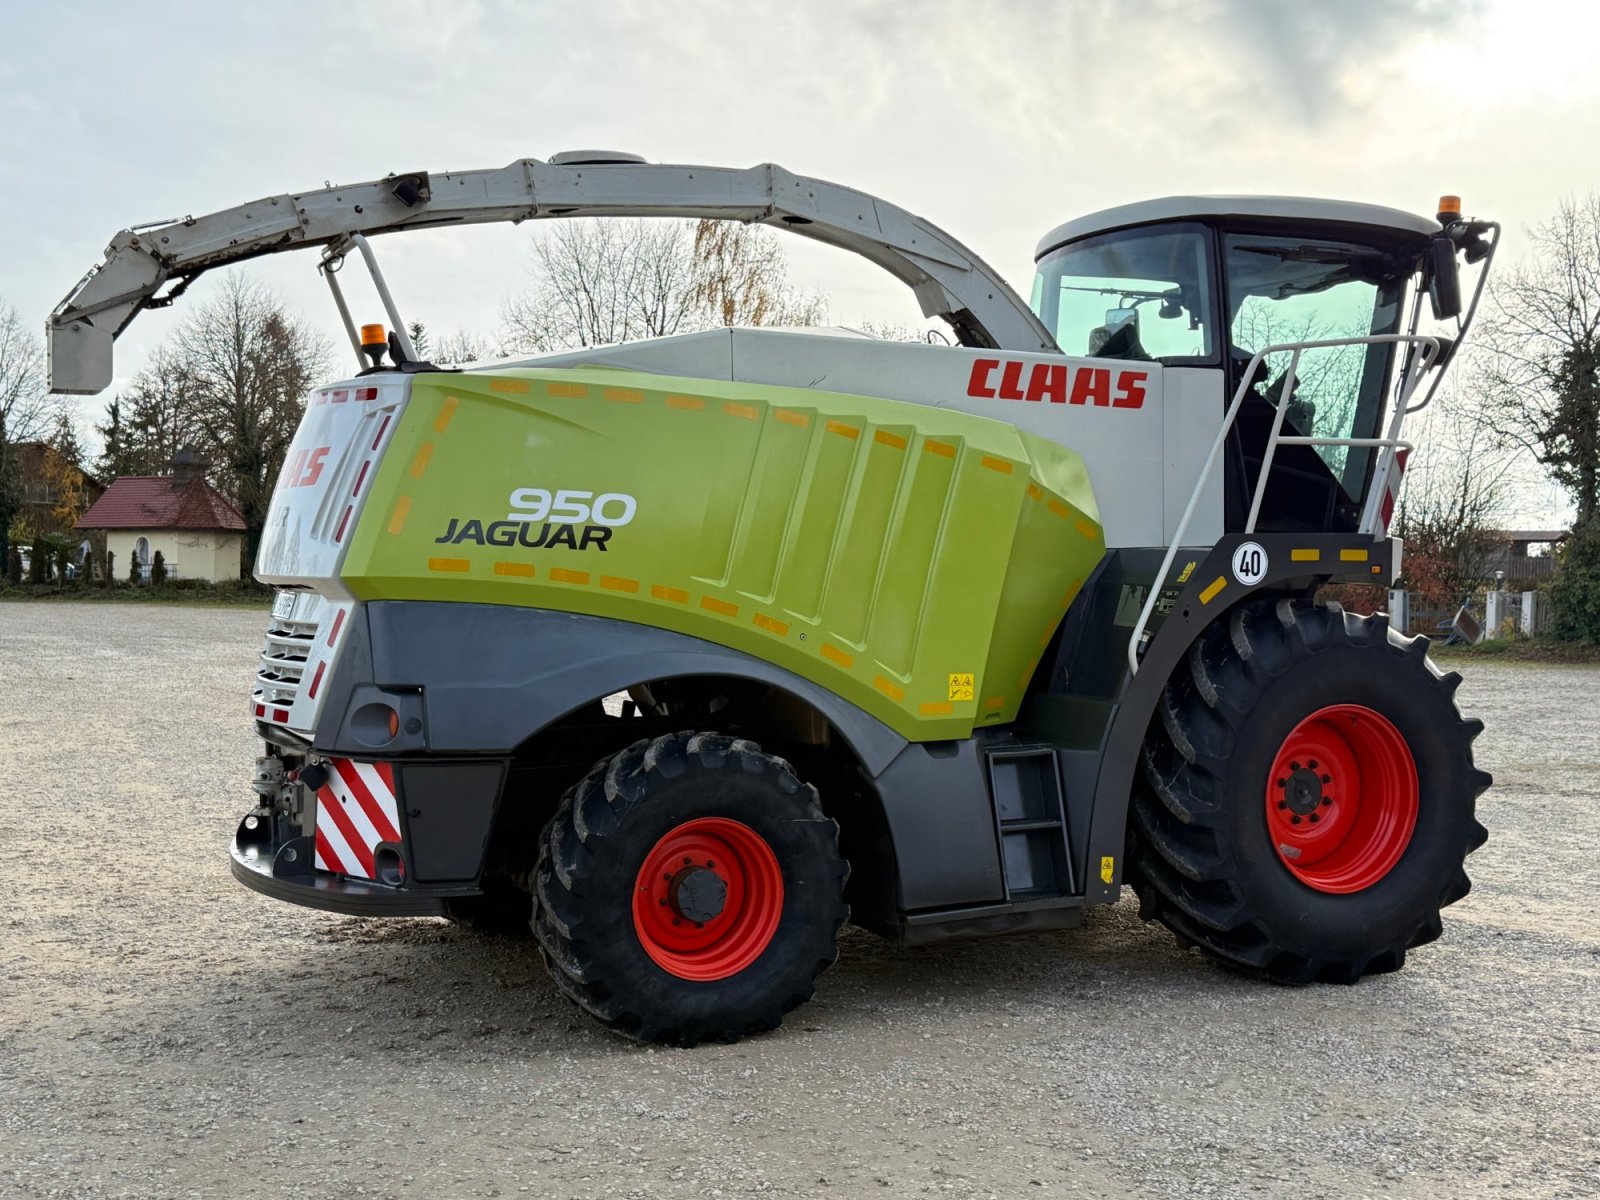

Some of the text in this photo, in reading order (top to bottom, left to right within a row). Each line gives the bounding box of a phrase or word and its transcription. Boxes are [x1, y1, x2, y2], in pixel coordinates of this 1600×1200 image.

[967, 358, 1148, 409] CLAAS
[507, 487, 637, 527] 950
[434, 518, 613, 551] JAGUAR
[1239, 550, 1261, 577] 40
